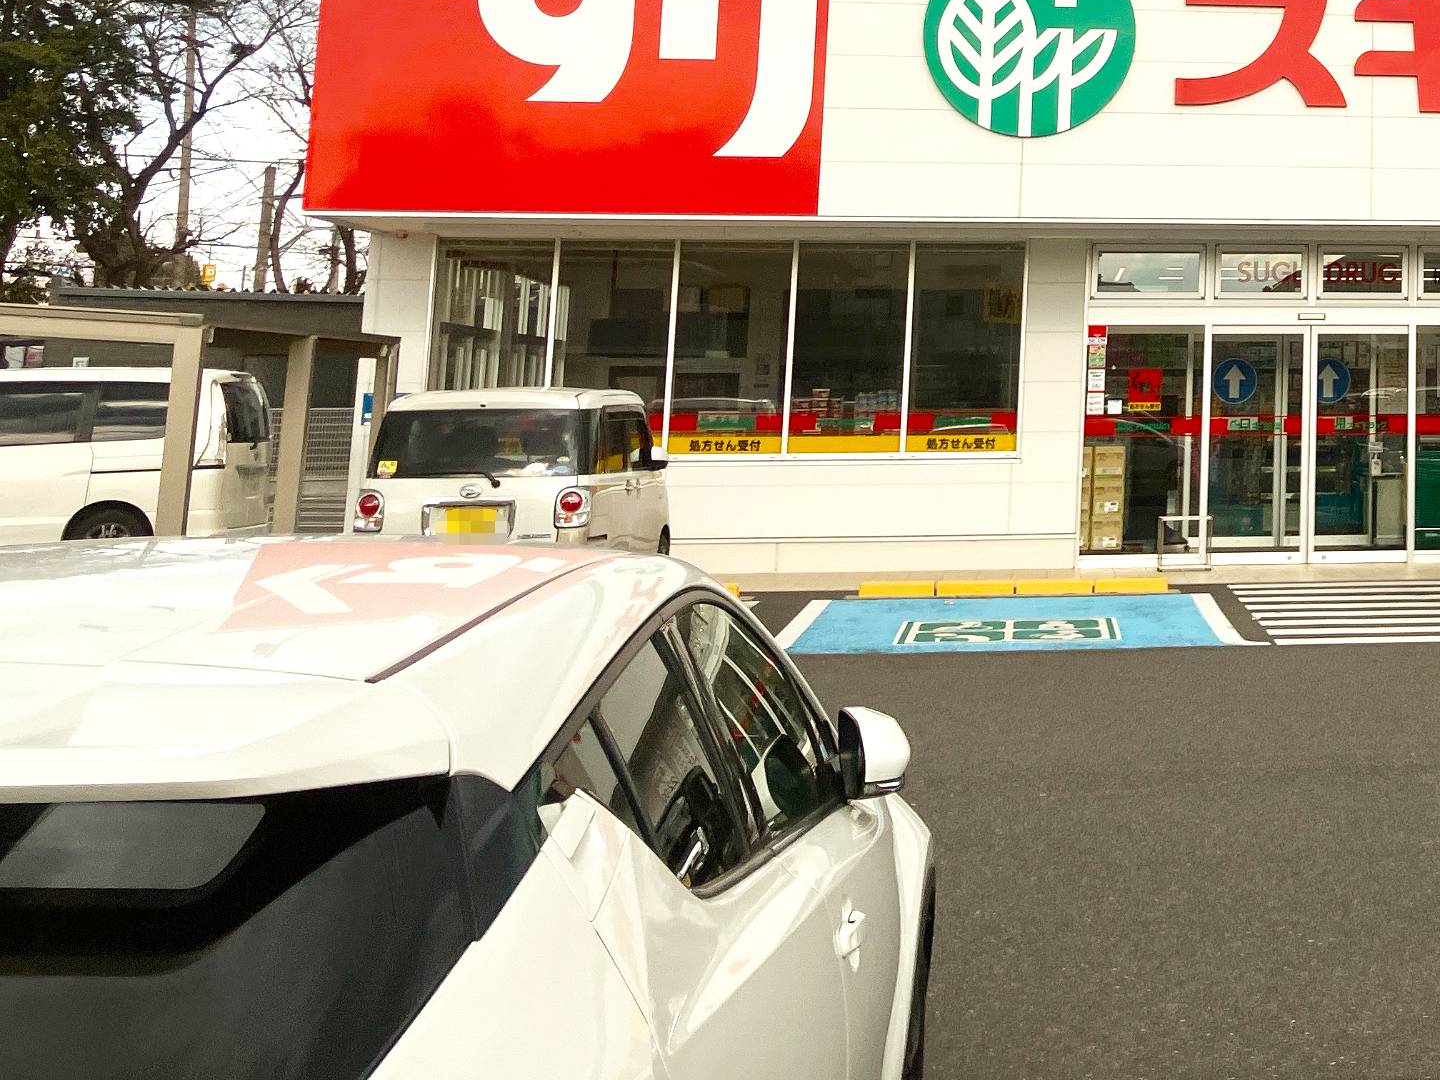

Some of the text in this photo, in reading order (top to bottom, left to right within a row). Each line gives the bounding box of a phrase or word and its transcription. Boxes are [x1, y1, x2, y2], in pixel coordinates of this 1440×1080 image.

[1237, 261, 1400, 284] SUGI DRUG
[689, 440, 761, 451] 処方せん受付
[926, 438, 995, 450] 処方せん受付
